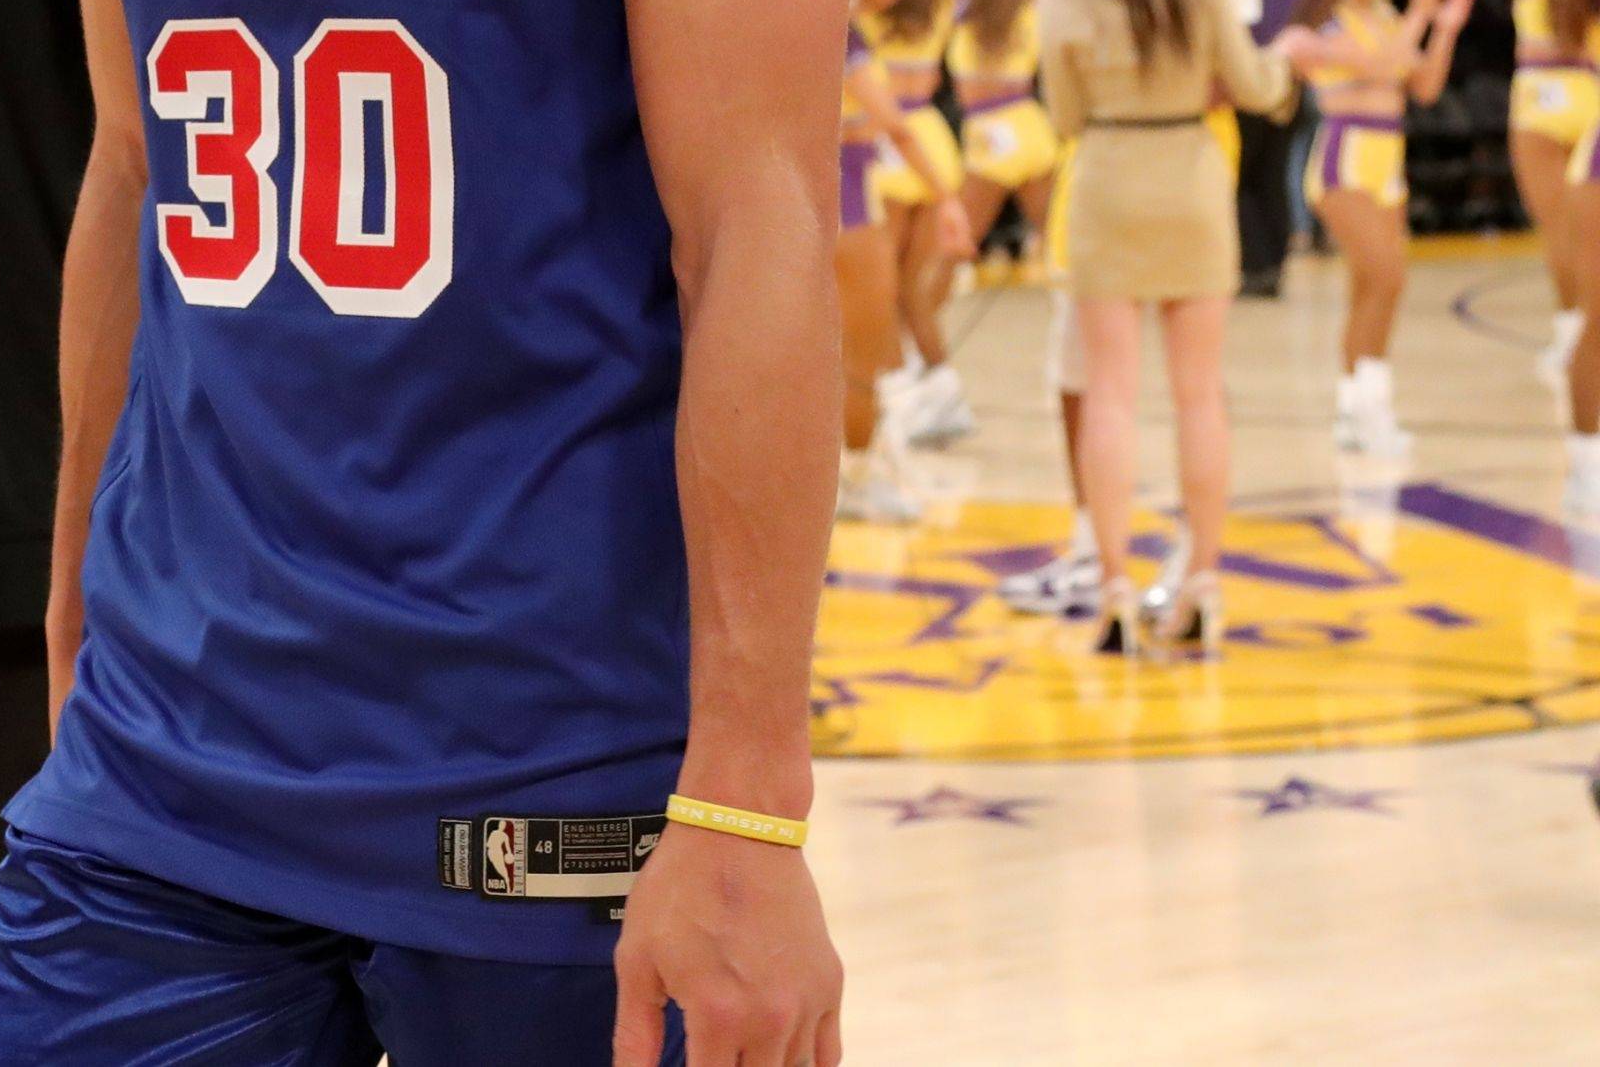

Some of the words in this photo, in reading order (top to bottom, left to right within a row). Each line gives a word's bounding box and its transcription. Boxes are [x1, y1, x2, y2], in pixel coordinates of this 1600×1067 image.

[146, 17, 454, 318] 30
[564, 823, 629, 833] ENGINEERED
[711, 811, 774, 835] JESUS
[535, 840, 553, 854] 48
[487, 879, 506, 890] NBA
